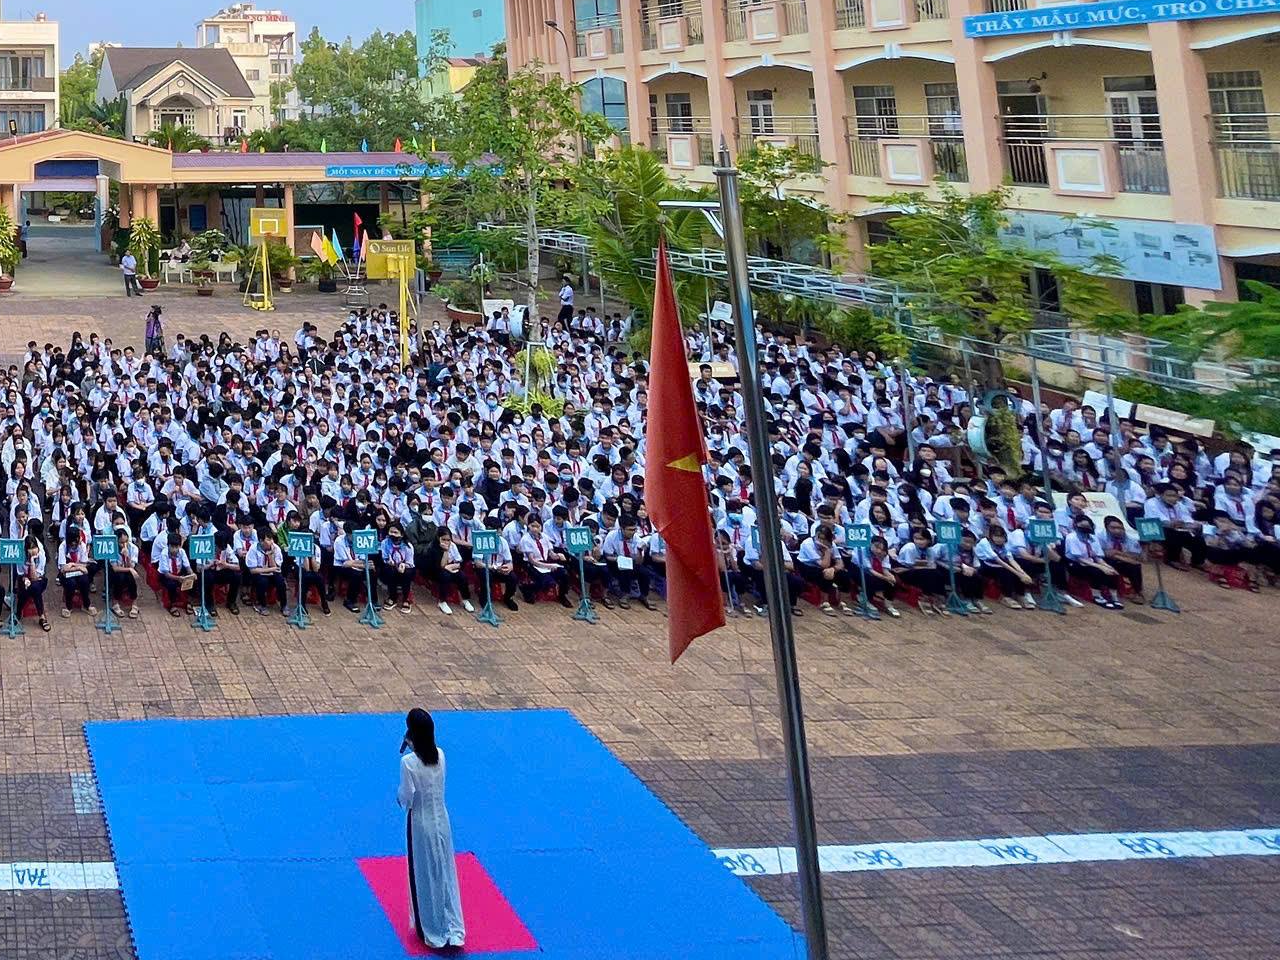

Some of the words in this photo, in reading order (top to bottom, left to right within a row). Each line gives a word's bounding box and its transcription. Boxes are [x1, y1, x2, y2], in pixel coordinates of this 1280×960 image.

[381, 244, 396, 252] Sun
[398, 244, 410, 252] Life
[848, 528, 867, 541] 8A2
[1034, 524, 1052, 537] 9A5
[291, 538, 311, 552] 7A1
[356, 535, 374, 549] 8A7
[476, 535, 495, 549] 8A6
[570, 532, 589, 546] 8A5
[3, 544, 20, 558] 7A4
[96, 540, 115, 555] 7A3
[194, 540, 211, 554] 7A2
[979, 843, 1038, 863] 8A4
[14, 862, 51, 887] 7A4
